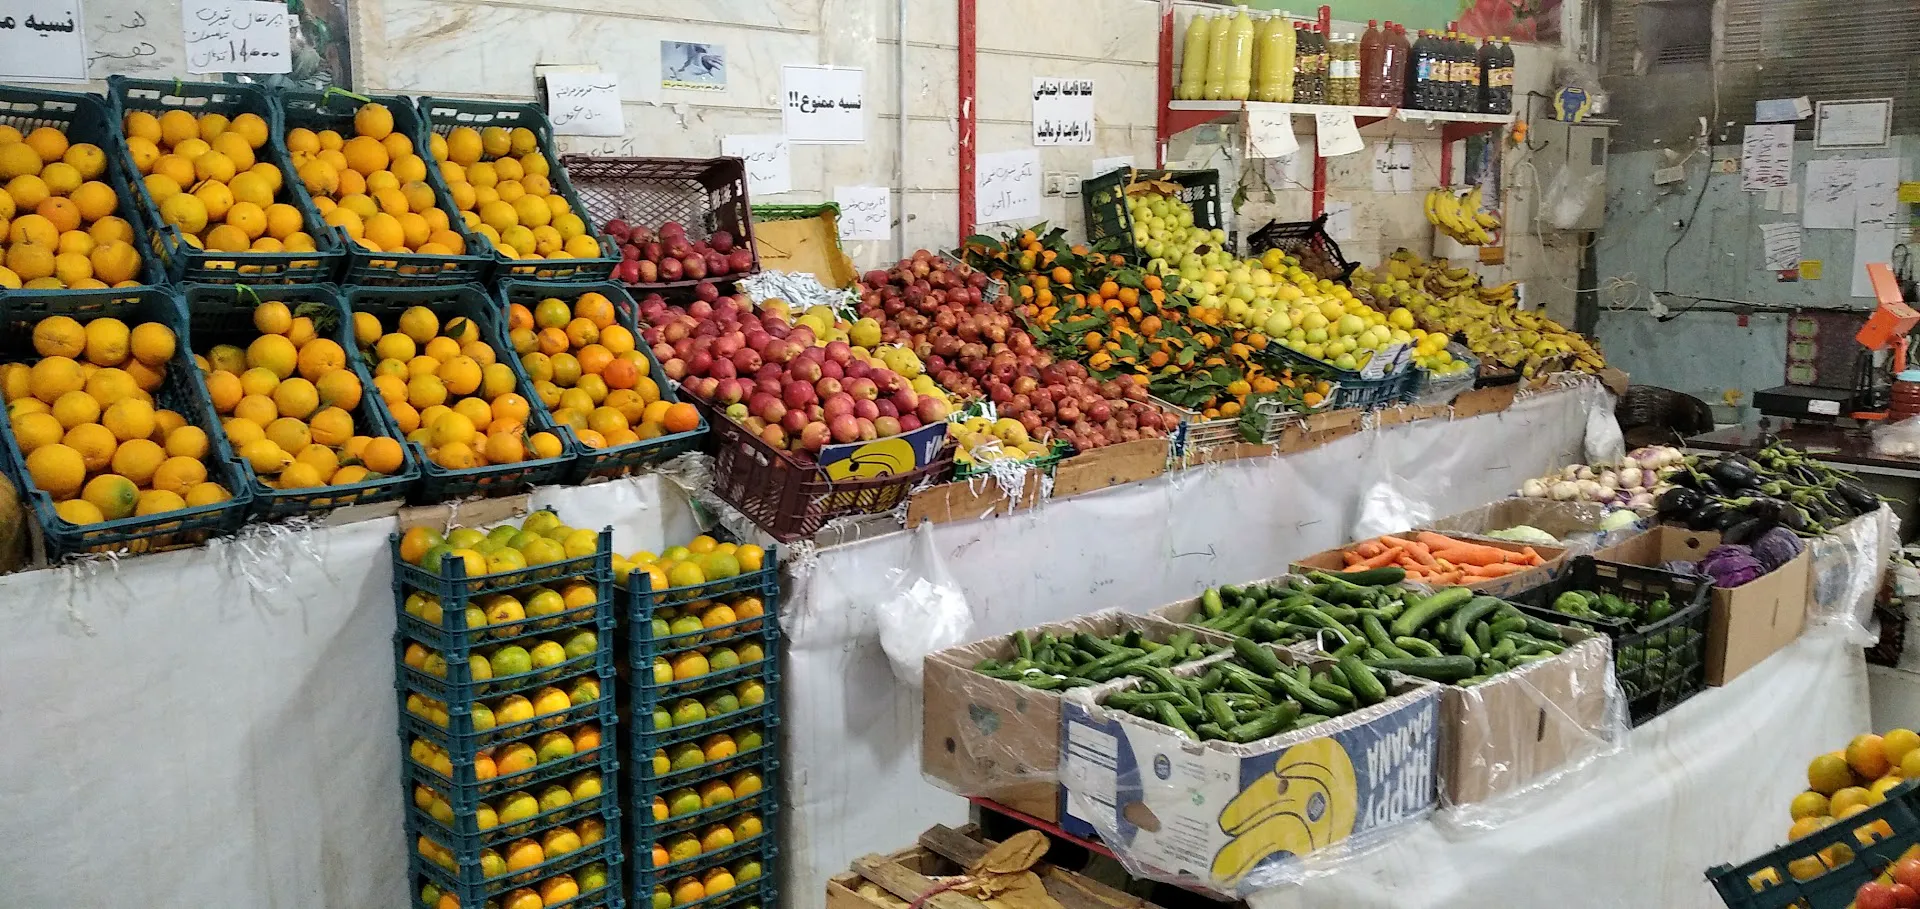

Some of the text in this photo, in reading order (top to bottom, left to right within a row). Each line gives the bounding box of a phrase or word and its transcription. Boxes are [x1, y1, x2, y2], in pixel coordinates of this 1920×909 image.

[25, 11, 74, 37] نسیه
[1034, 81, 1060, 100] اجتماعی
[1062, 80, 1079, 96] فاصله
[789, 91, 862, 113] نسیه ممنوع!!
[1061, 121, 1083, 142] رعایت
[1366, 703, 1433, 789] BANANA
[1362, 733, 1432, 831] HAPPY
